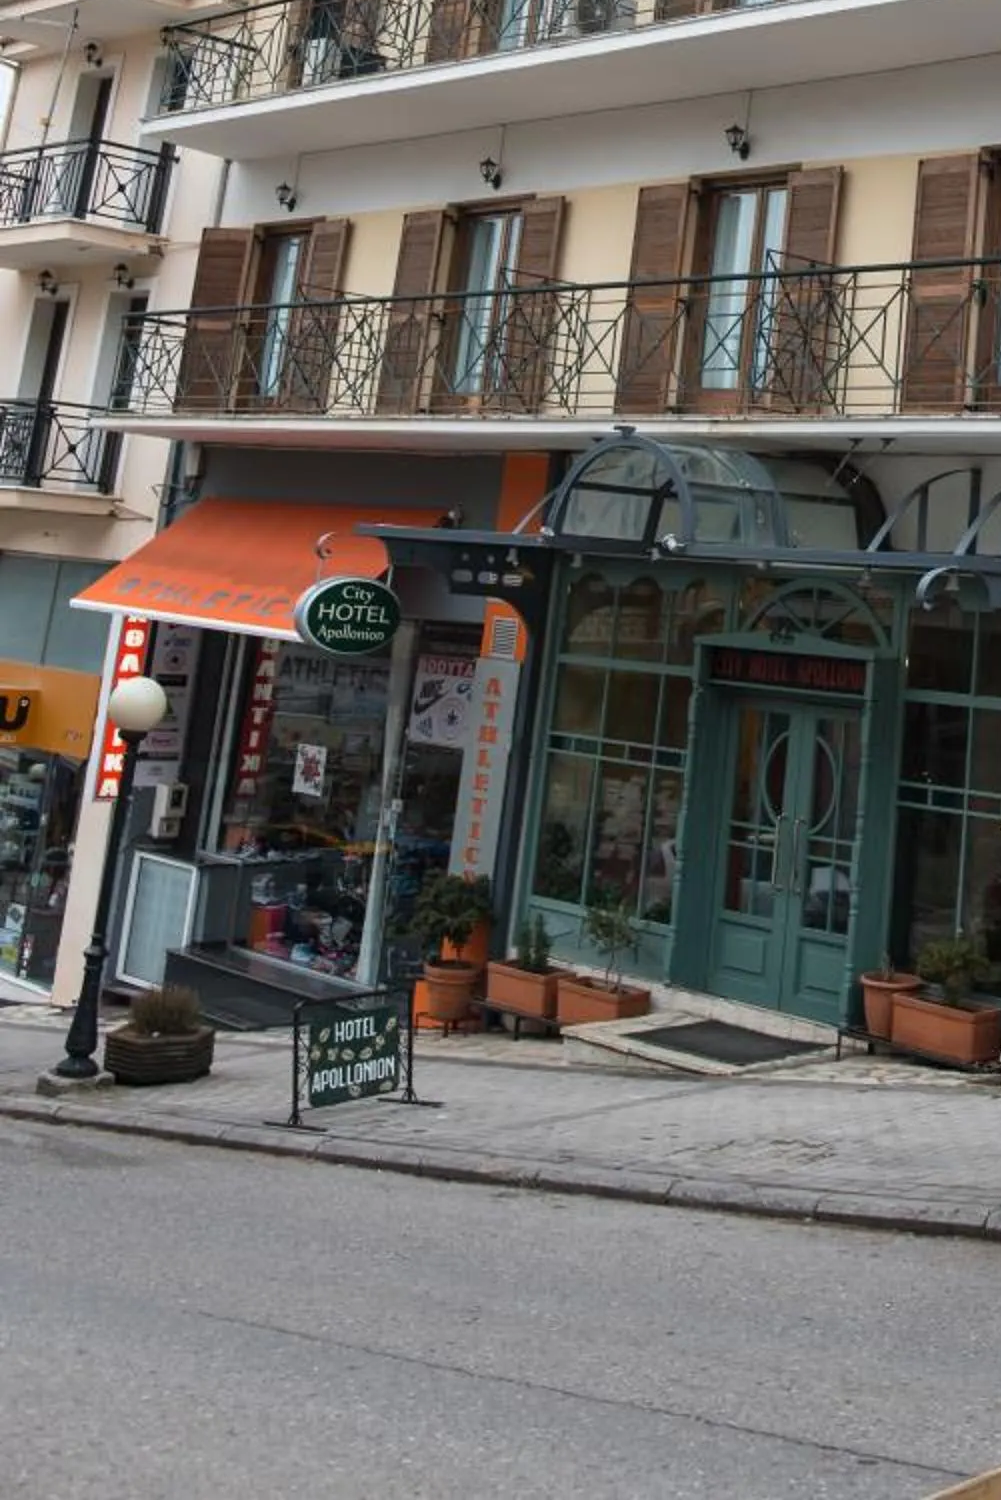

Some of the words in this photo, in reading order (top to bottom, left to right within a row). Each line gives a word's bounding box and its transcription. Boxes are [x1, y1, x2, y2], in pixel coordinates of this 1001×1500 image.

[116, 576, 297, 621] ATHLETIC
[342, 584, 375, 605] City
[317, 603, 390, 624] HOTEL
[317, 624, 385, 643] Apollonion
[334, 1016, 377, 1043] HOTEL
[312, 1055, 395, 1094] APOLLONION
